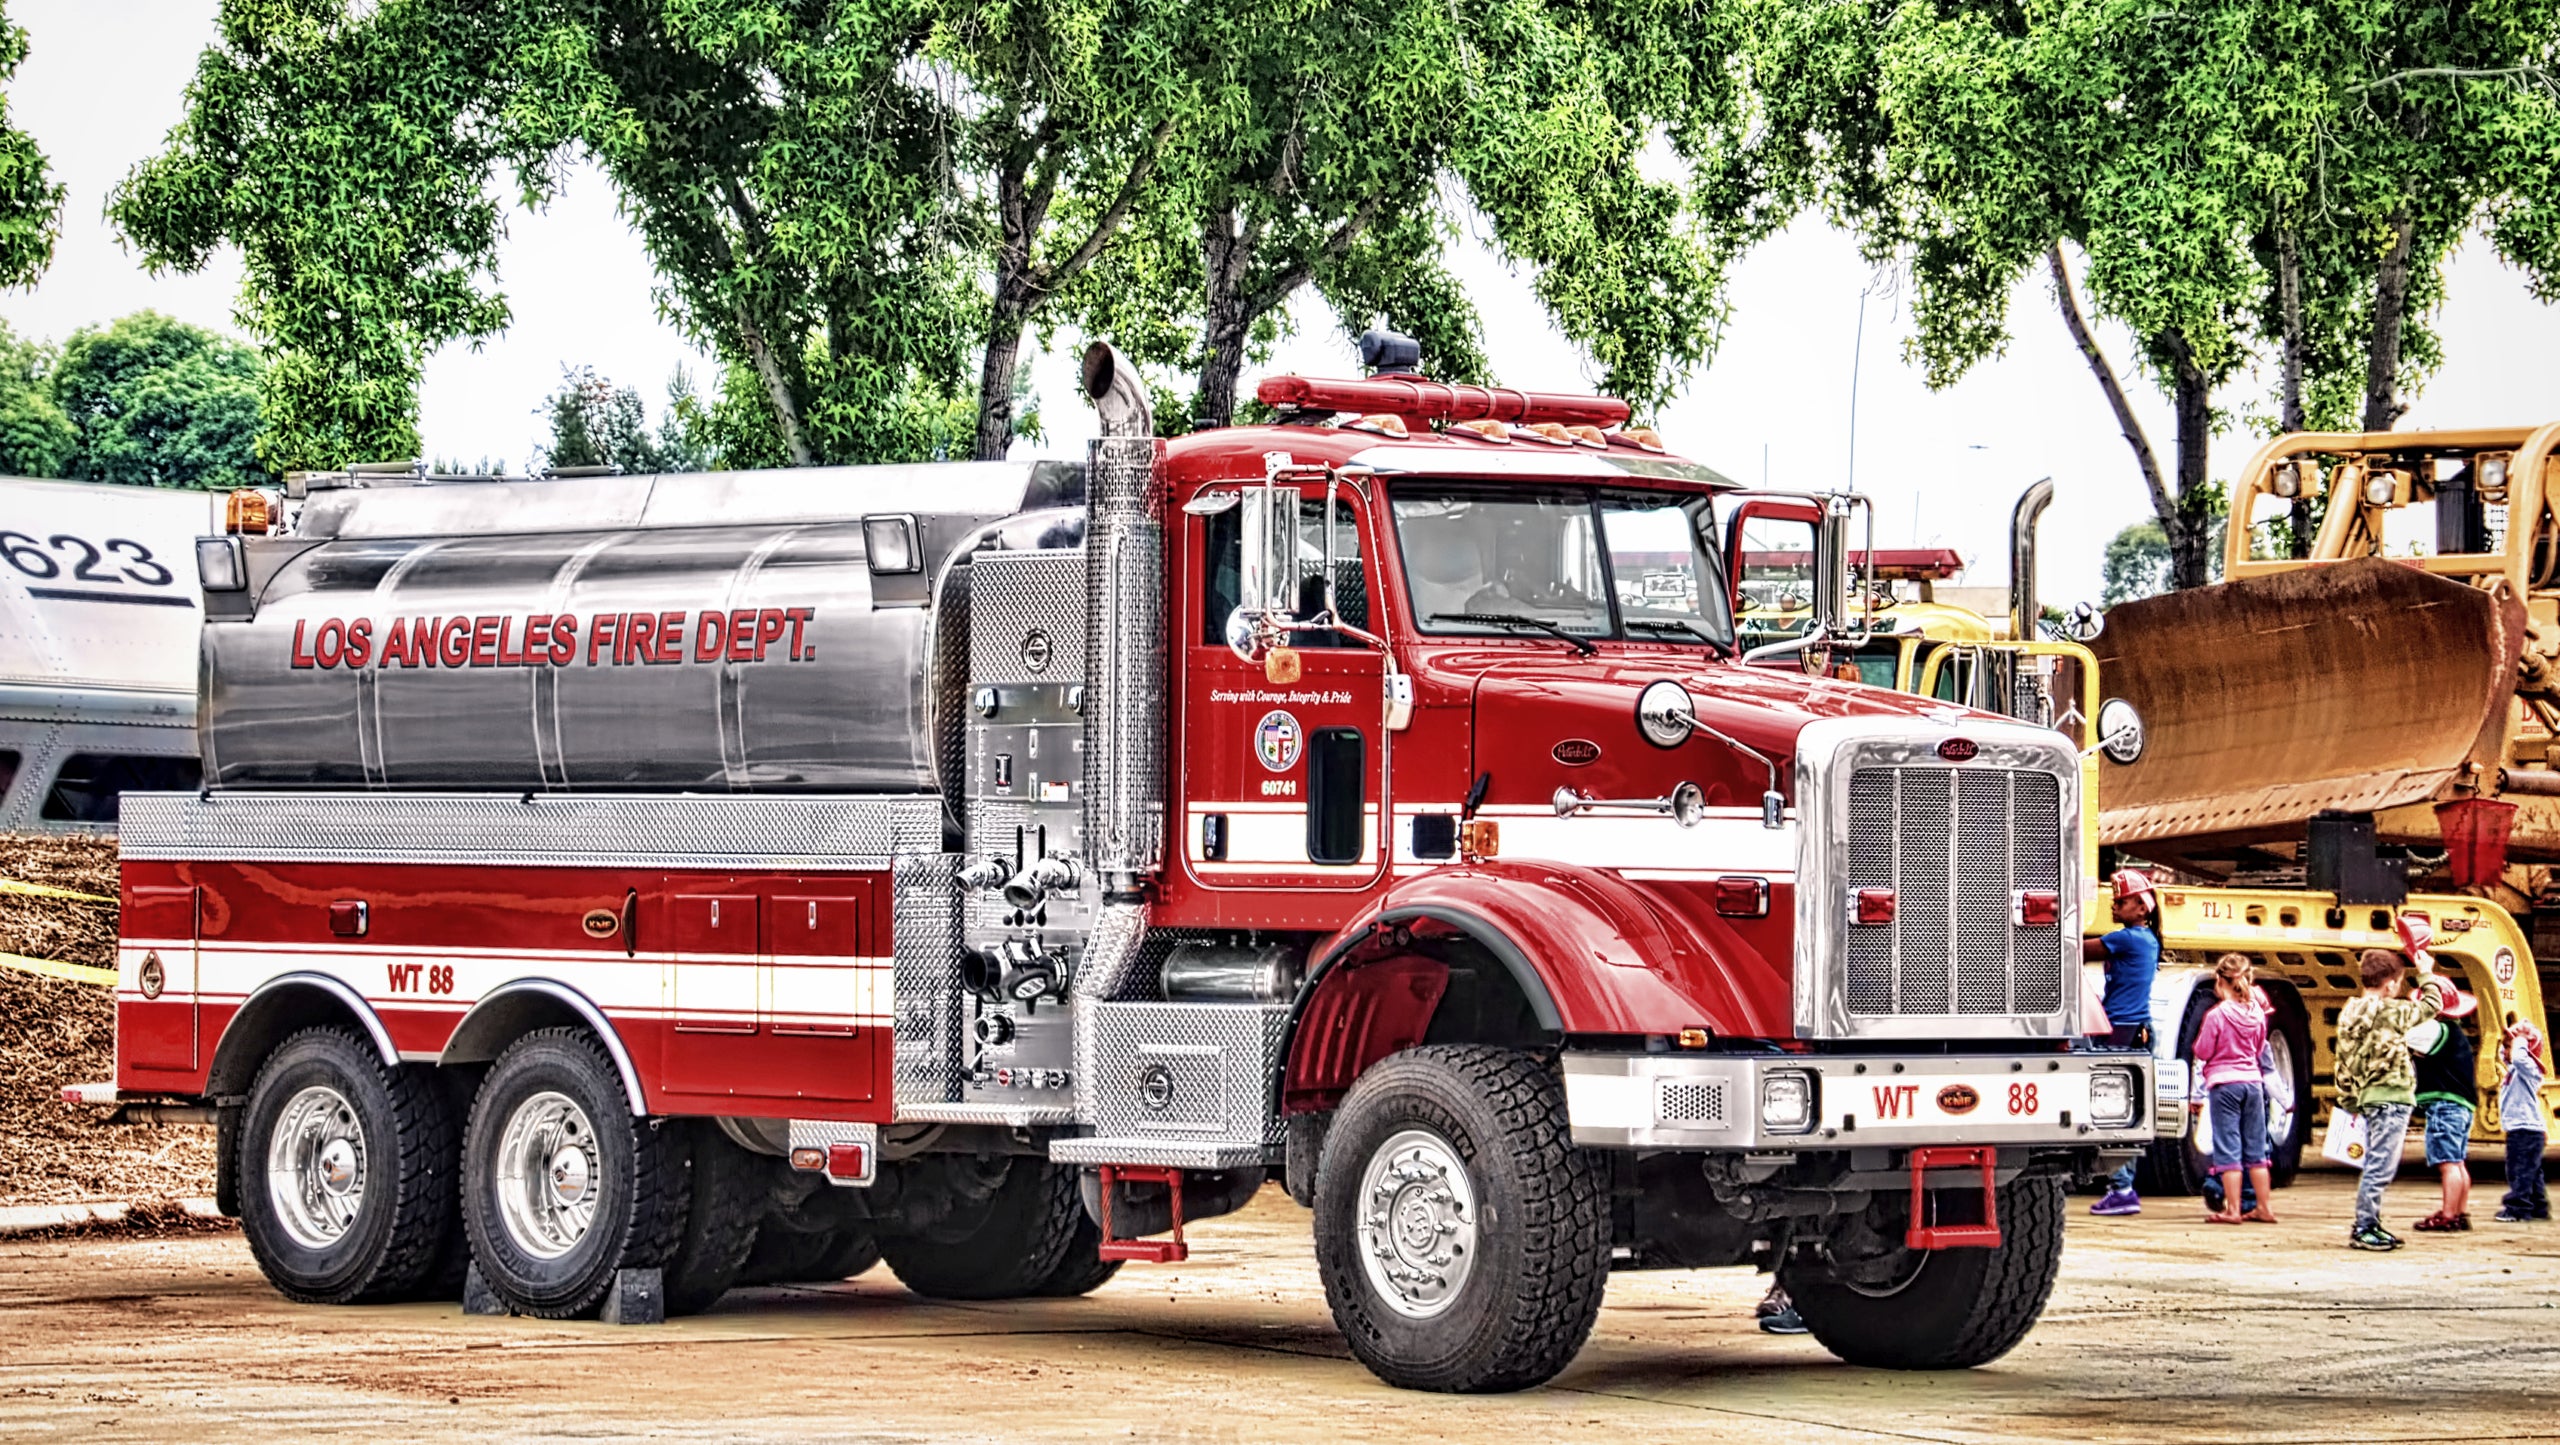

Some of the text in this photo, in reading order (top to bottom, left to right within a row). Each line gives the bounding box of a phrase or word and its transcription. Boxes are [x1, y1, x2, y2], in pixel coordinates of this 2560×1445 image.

[291, 607, 816, 669] LOS ANGELES FIRE DEPT.
[1210, 689, 1352, 705] Serving with Courage, Integrity & Pride
[1261, 780, 1297, 796] 60741
[2202, 901, 2233, 919] TL 1
[387, 963, 454, 995] WT 88
[1872, 1084, 1920, 1120] WT
[2007, 1082, 2039, 1116] 88
